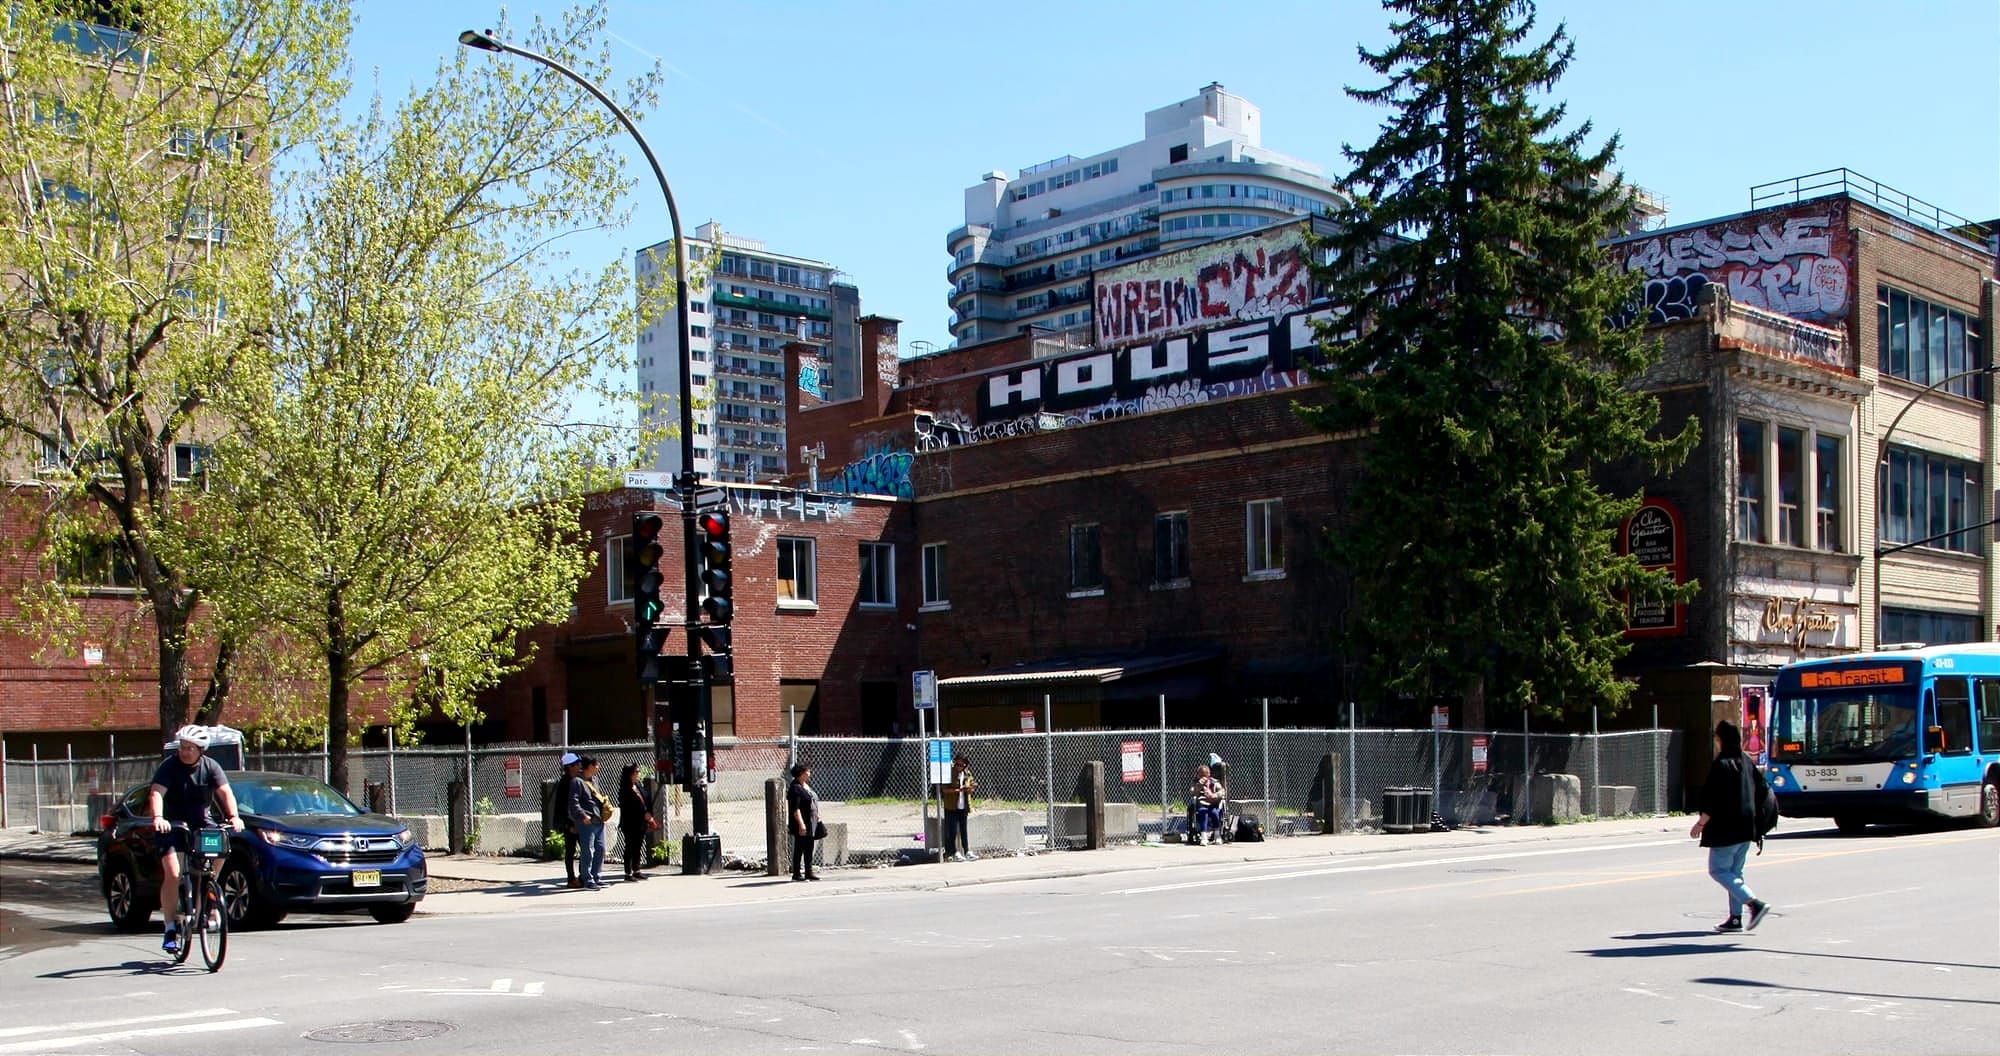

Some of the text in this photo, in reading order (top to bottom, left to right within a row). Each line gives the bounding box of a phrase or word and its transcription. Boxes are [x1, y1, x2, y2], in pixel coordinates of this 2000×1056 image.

[628, 476, 648, 485] Parc
[1817, 670, 1888, 687] En Transit
[1805, 768, 1838, 777] 33-833
